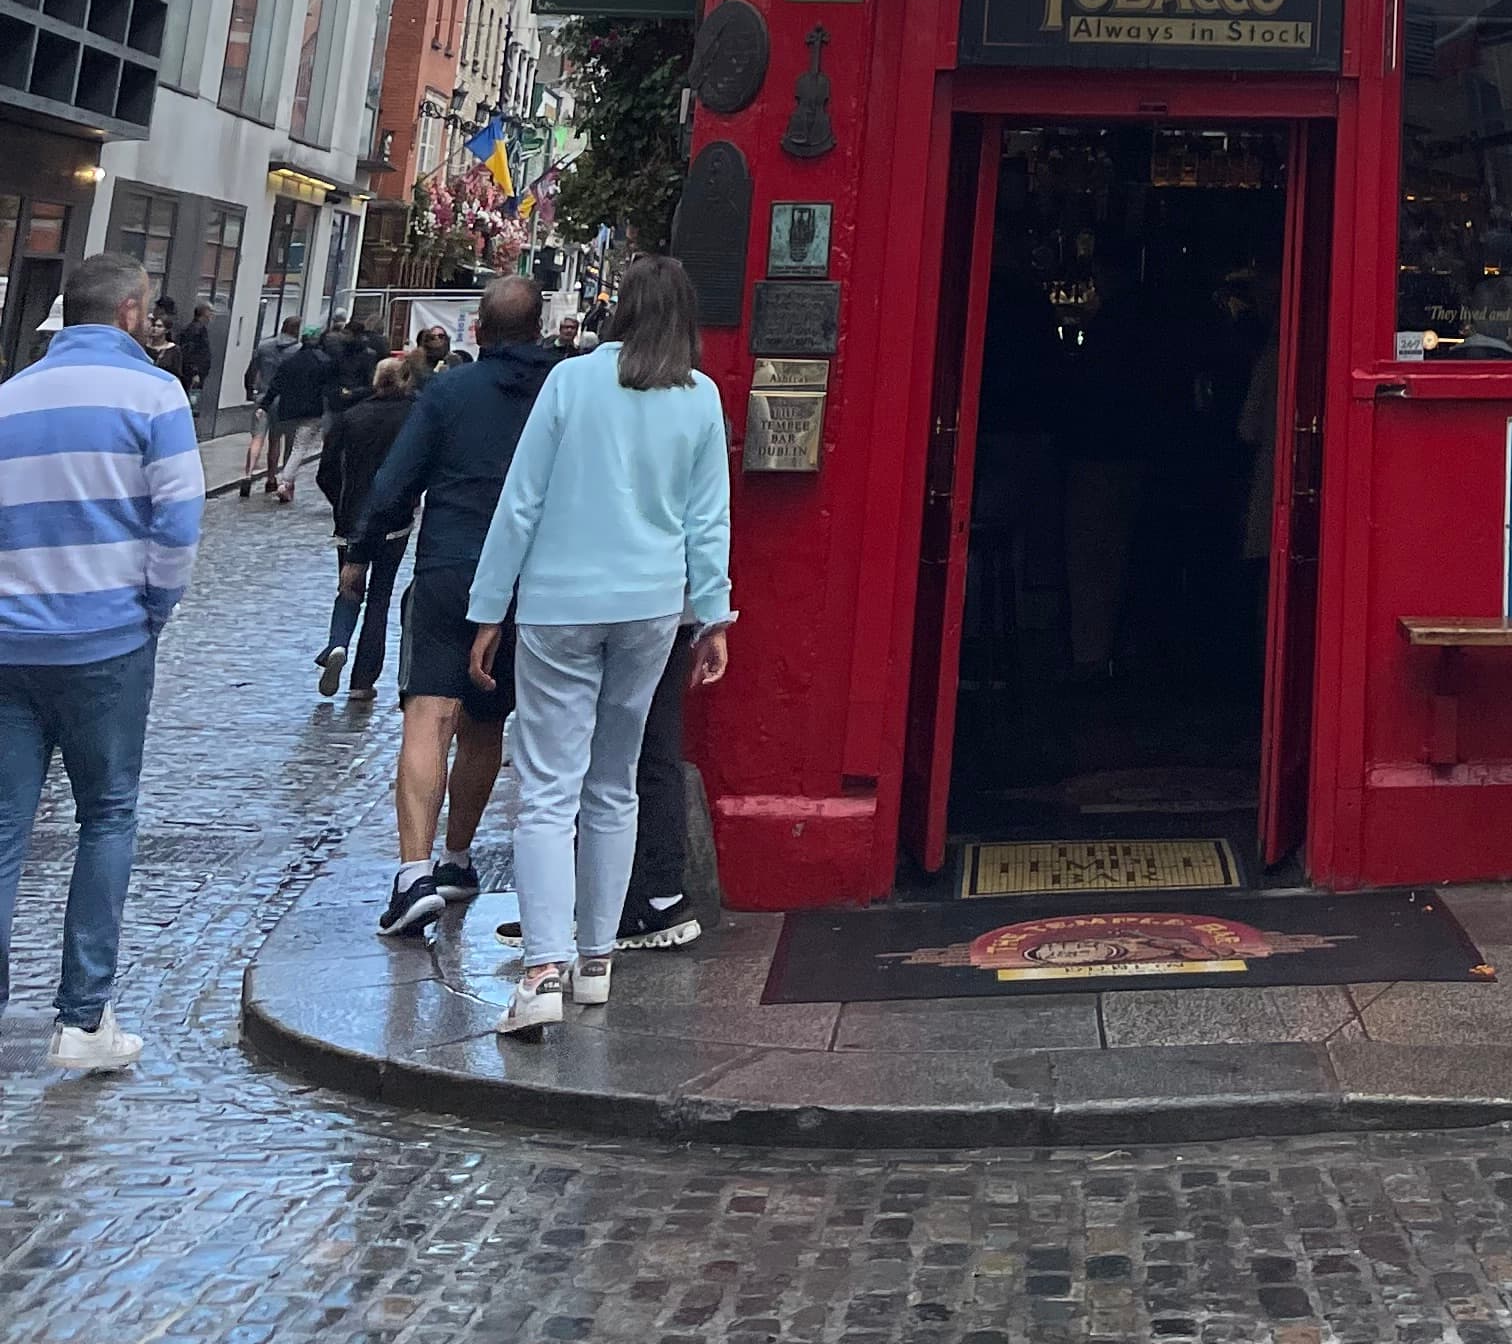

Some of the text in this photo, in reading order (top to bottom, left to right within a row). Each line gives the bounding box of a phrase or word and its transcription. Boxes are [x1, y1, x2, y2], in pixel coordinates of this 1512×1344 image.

[1073, 17, 1306, 45] Always in Stock
[771, 433, 796, 444] BAR
[758, 446, 808, 457] DUBLIN
